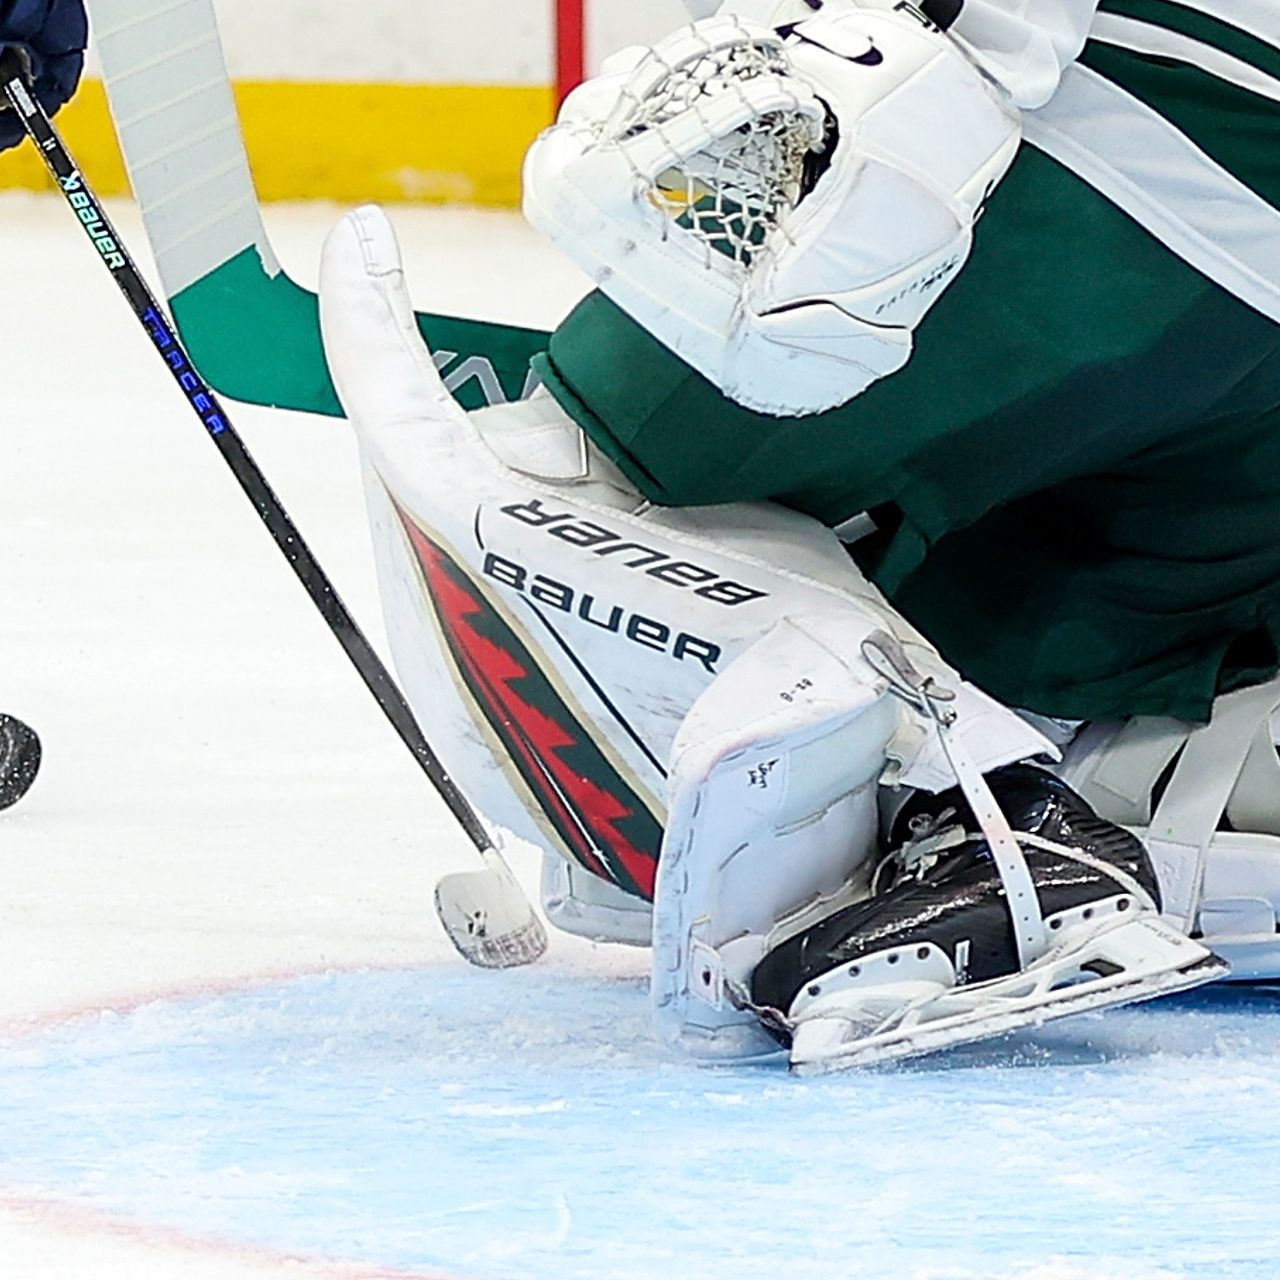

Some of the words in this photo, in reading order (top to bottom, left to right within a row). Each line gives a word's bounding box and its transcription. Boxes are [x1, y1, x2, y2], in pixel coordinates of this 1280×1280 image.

[69, 191, 126, 270] BAUER
[499, 498, 771, 607] BAUER
[482, 551, 721, 675] BAUER
